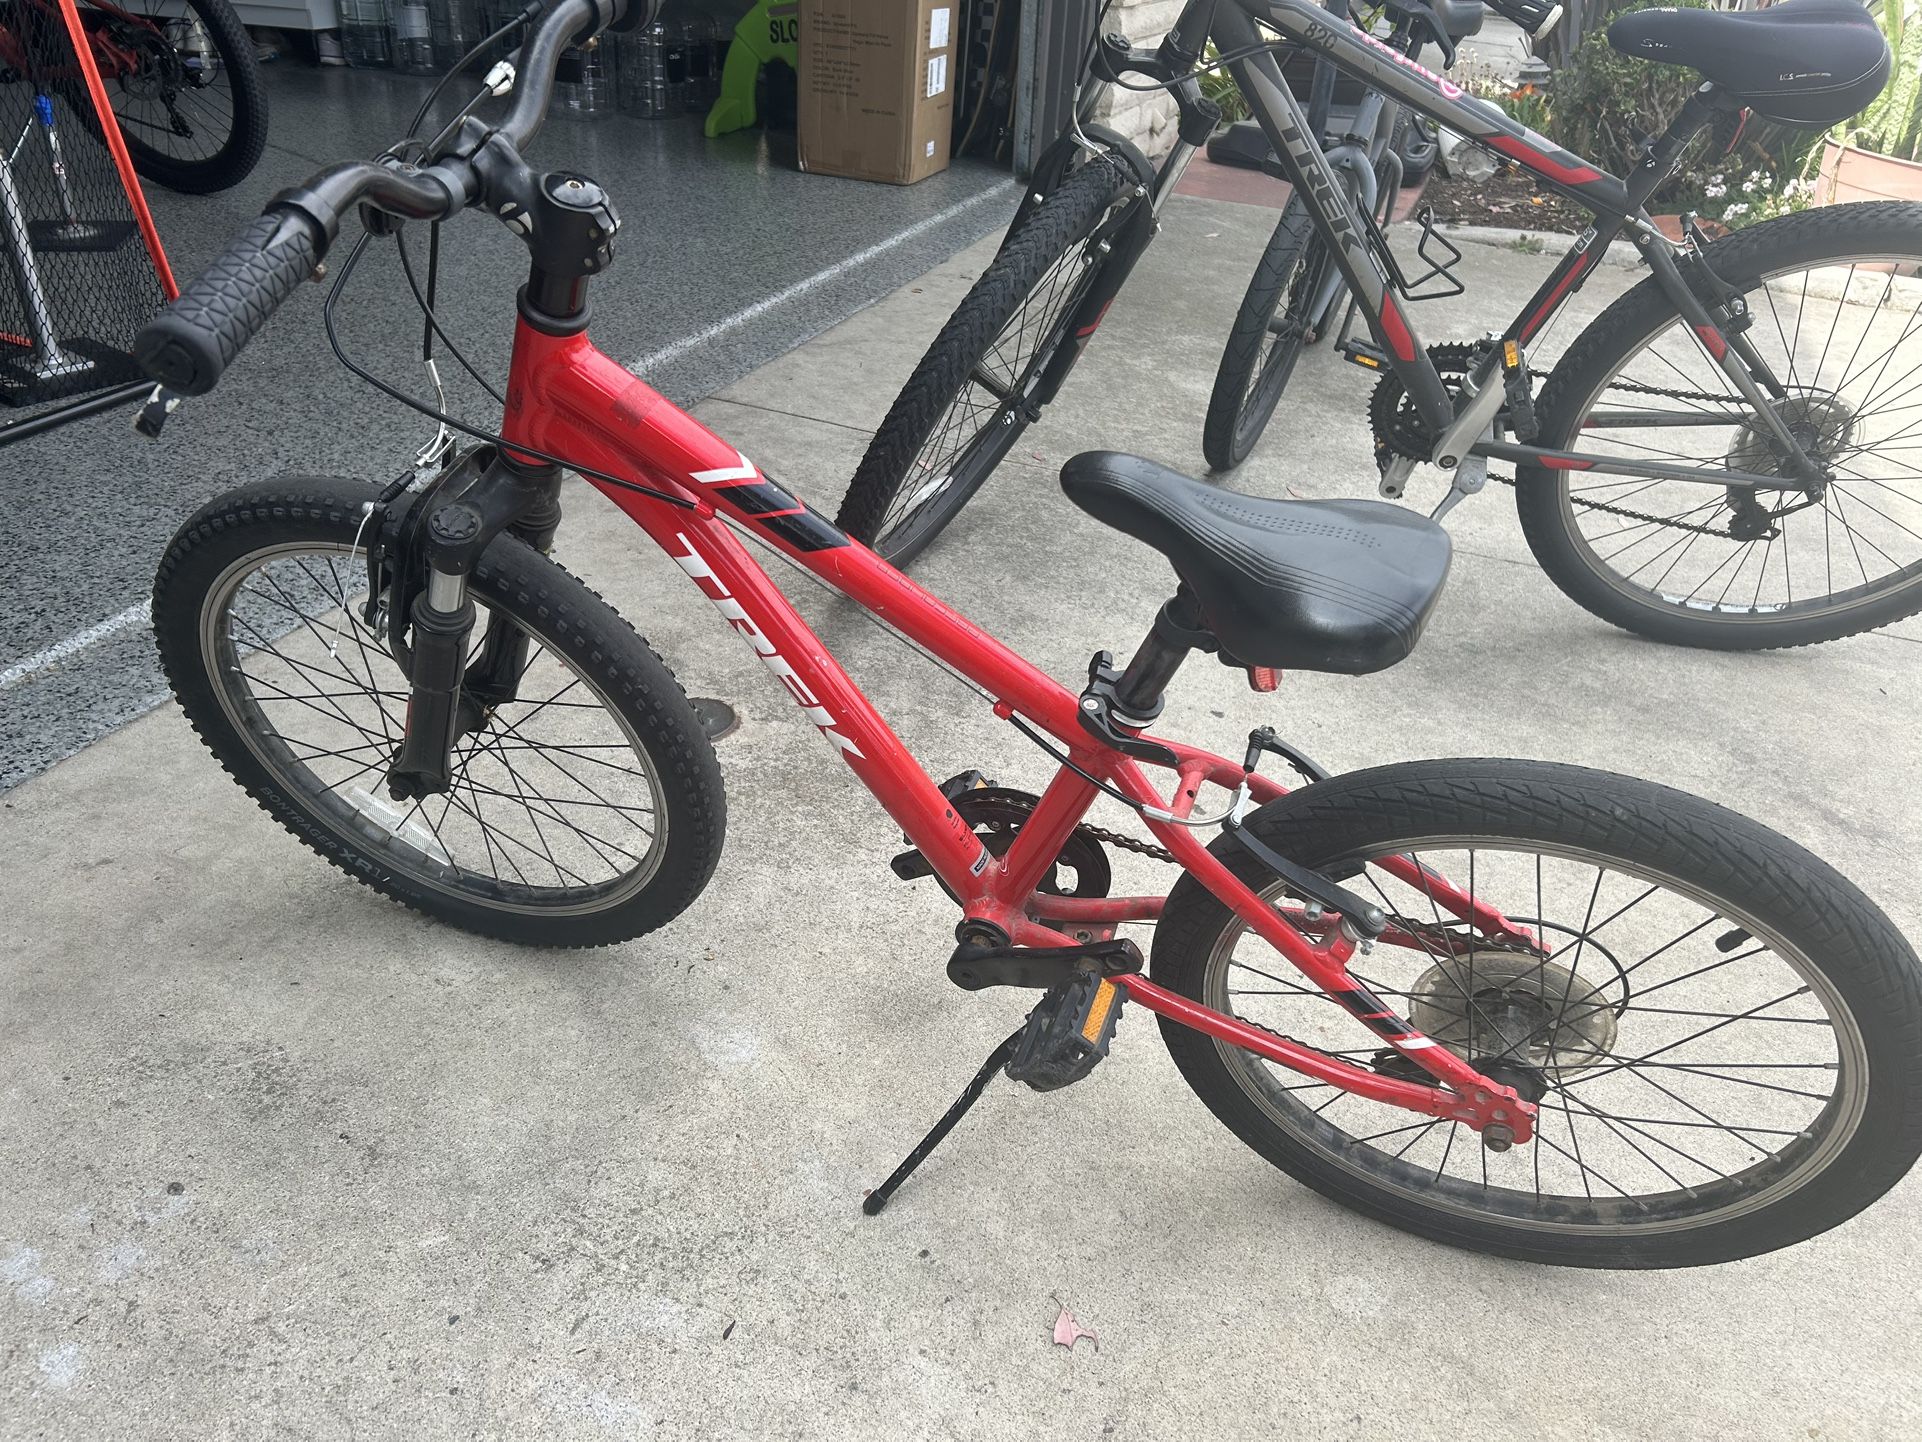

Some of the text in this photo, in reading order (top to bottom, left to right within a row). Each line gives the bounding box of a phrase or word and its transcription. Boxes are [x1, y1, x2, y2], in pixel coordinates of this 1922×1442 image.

[1303, 22, 1338, 49] 820
[1281, 112, 1363, 255] TREK
[673, 532, 867, 760] TREK
[259, 785, 381, 879] BONTRAGER XR1
